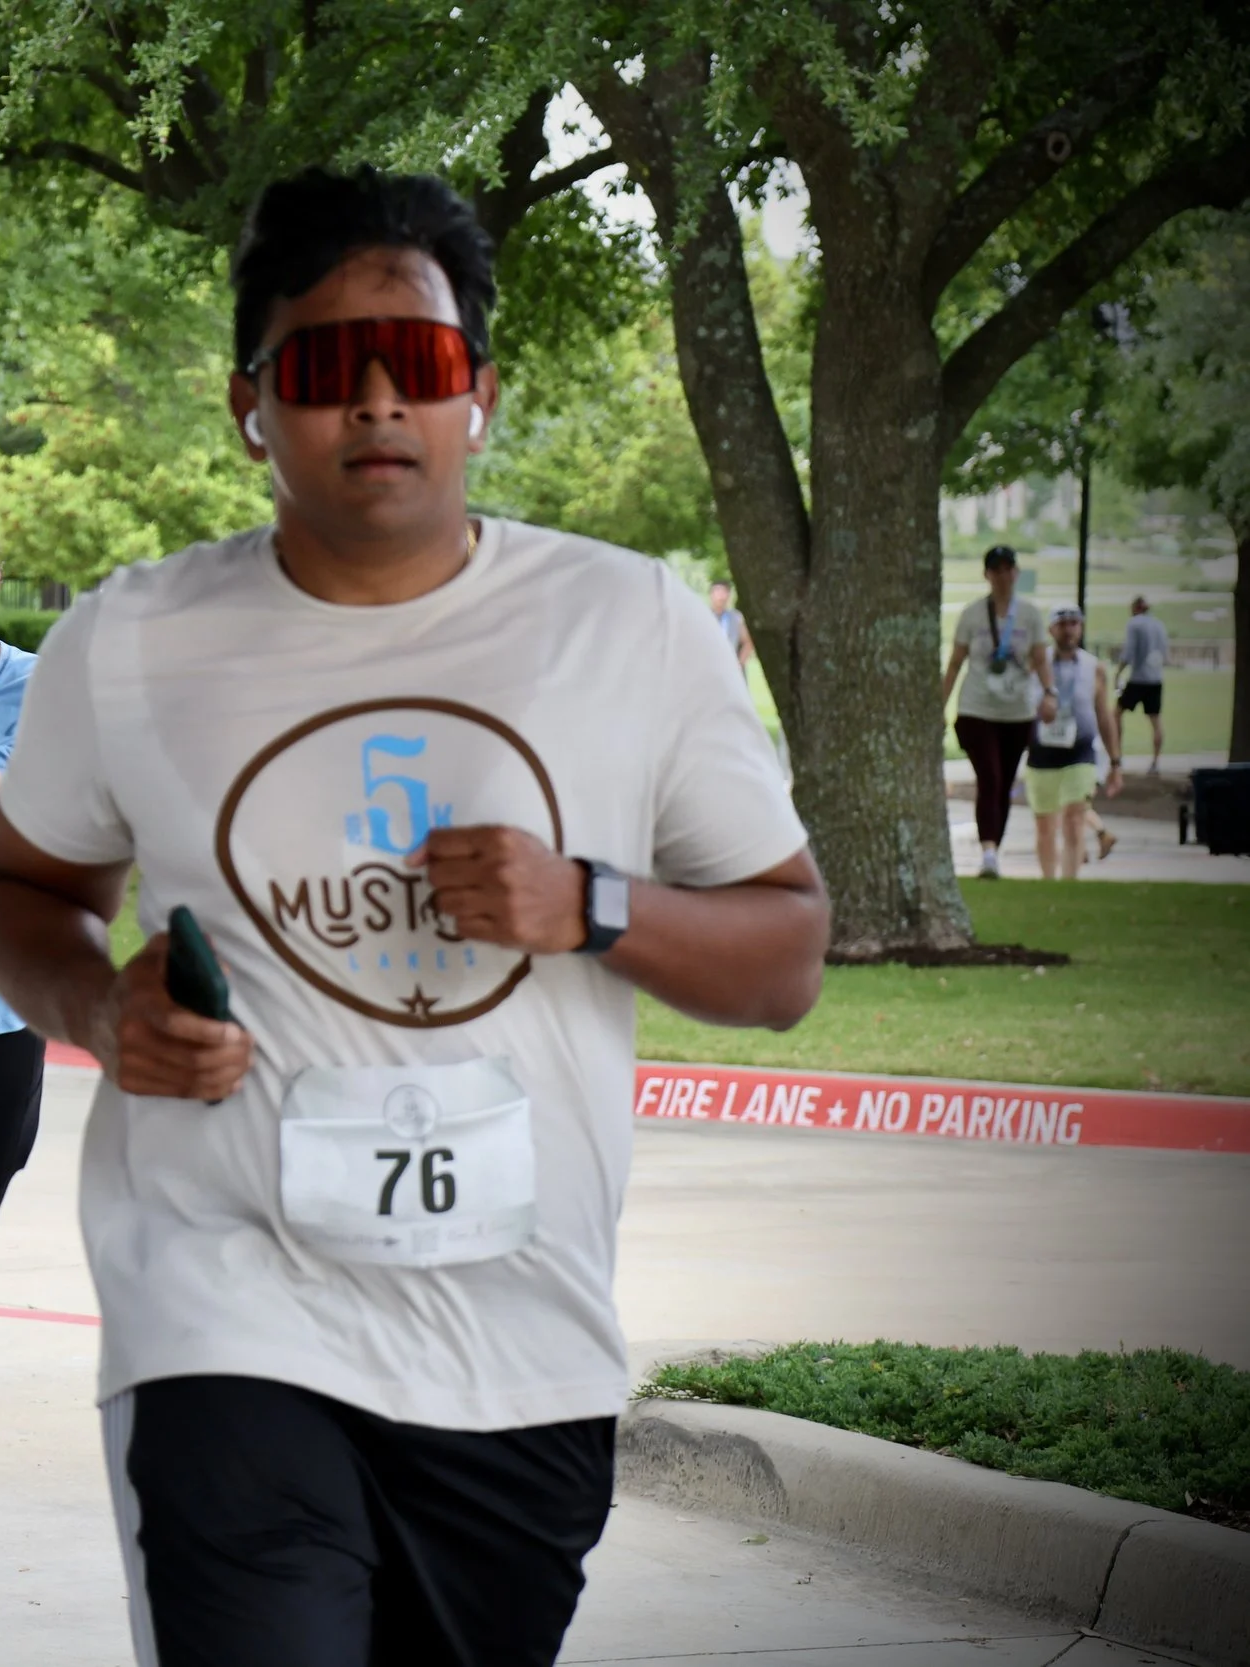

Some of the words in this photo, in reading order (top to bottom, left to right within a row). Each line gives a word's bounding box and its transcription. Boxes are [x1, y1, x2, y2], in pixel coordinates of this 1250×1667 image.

[268, 862, 467, 949] MUST
[635, 1076, 719, 1118] FIRE
[720, 1081, 822, 1127] LANE
[853, 1089, 911, 1131] NO
[916, 1092, 1085, 1146] PARKING
[374, 1147, 457, 1216] 76
